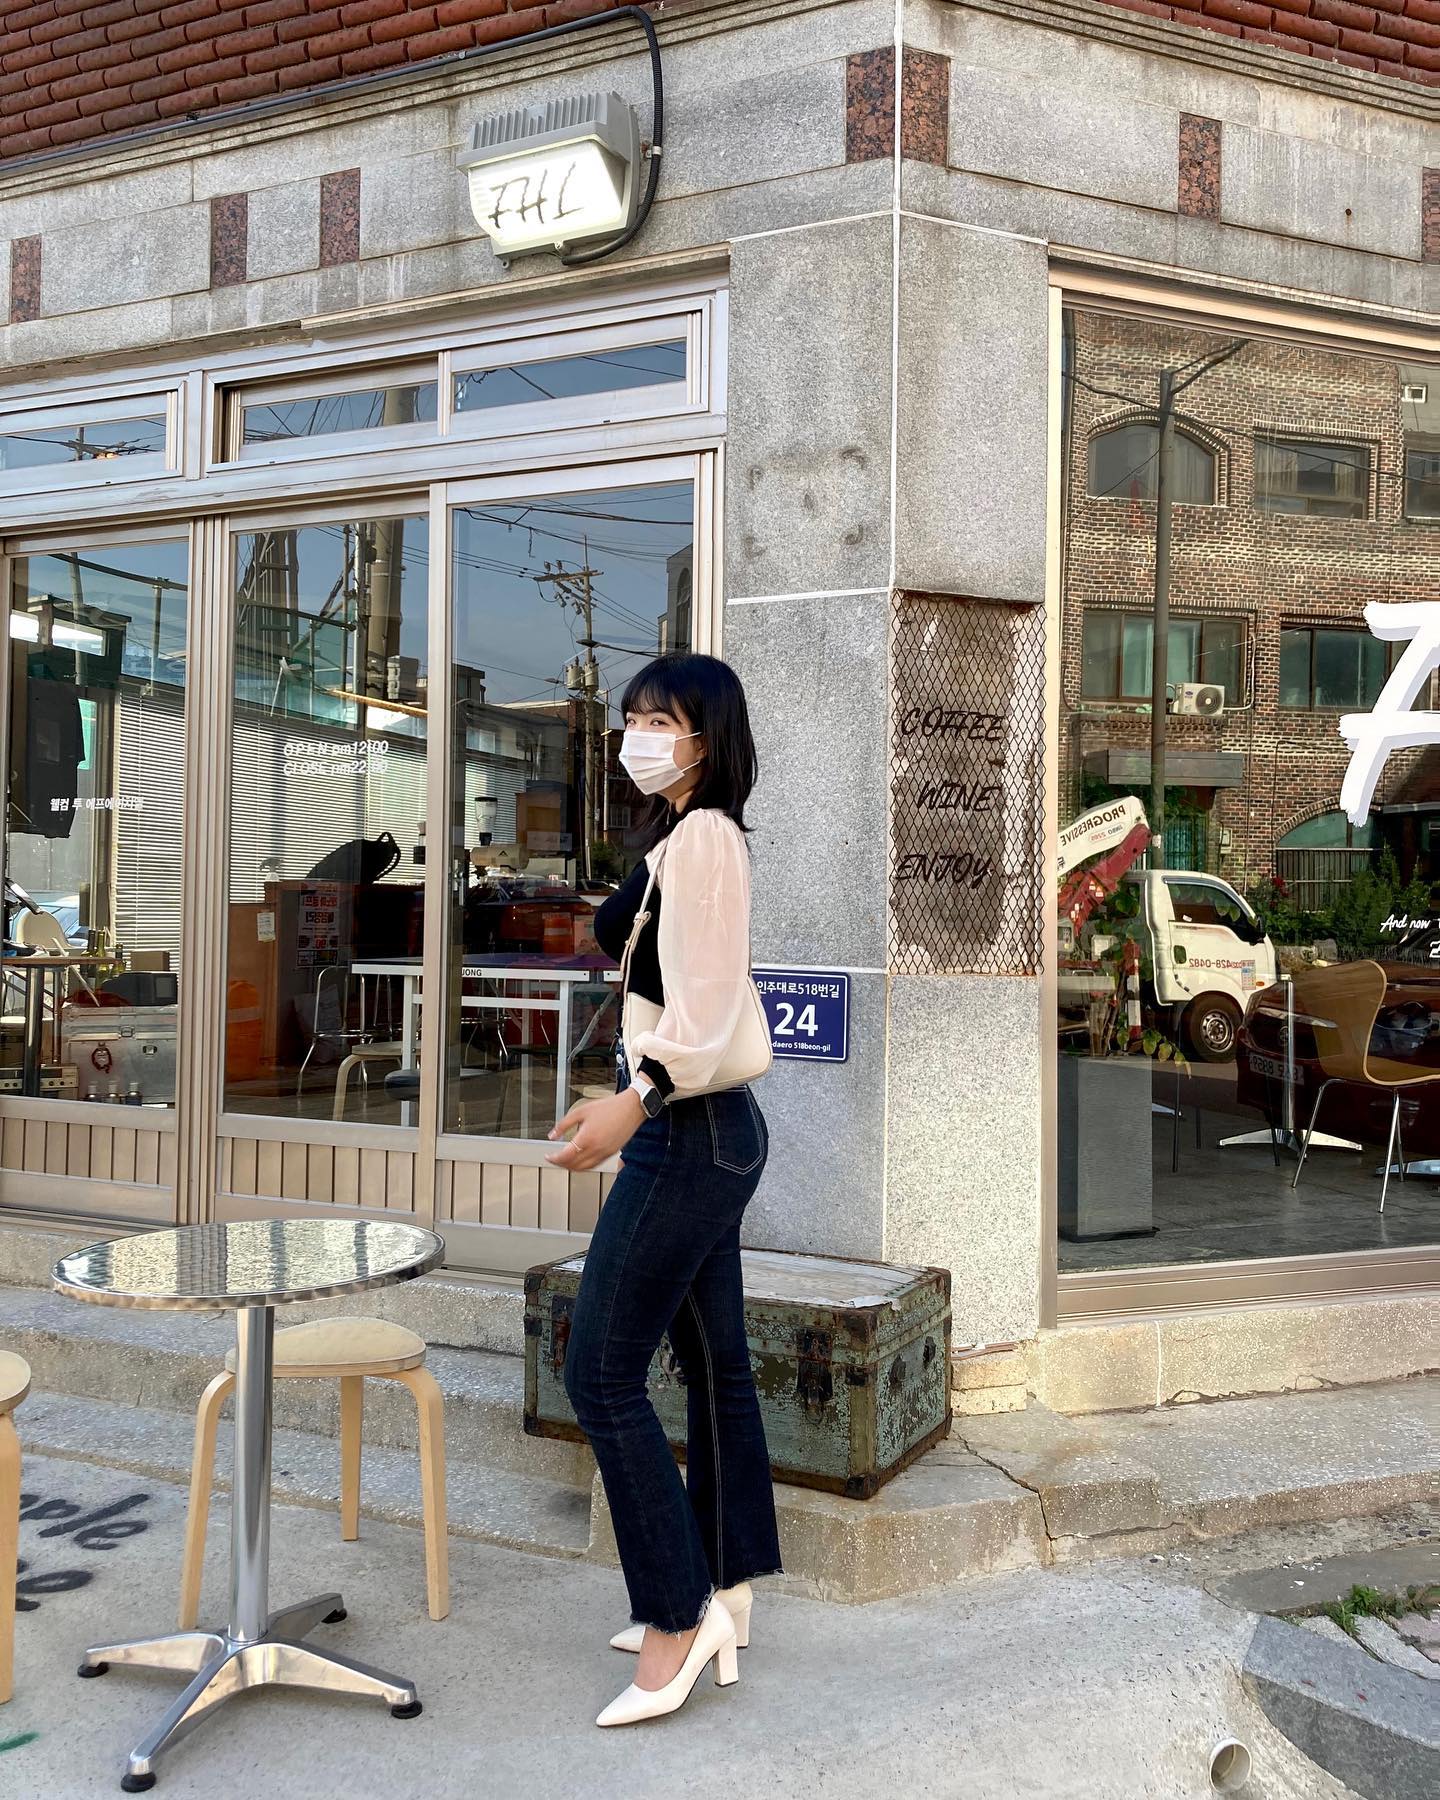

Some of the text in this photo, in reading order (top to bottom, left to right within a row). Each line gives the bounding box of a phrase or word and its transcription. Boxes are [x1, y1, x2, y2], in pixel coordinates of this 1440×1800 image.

[901, 707, 1005, 741] COFFEE
[50, 797, 69, 811] 웰컴
[72, 797, 82, 810] 투
[916, 780, 1003, 812] WINE
[894, 852, 994, 889] ENJOY
[1379, 913, 1408, 933] And
[1409, 919, 1431, 929] now
[756, 980, 840, 998] 인주대로518번길
[773, 1002, 819, 1037] 24
[793, 1042, 831, 1053] 518beon-gil
